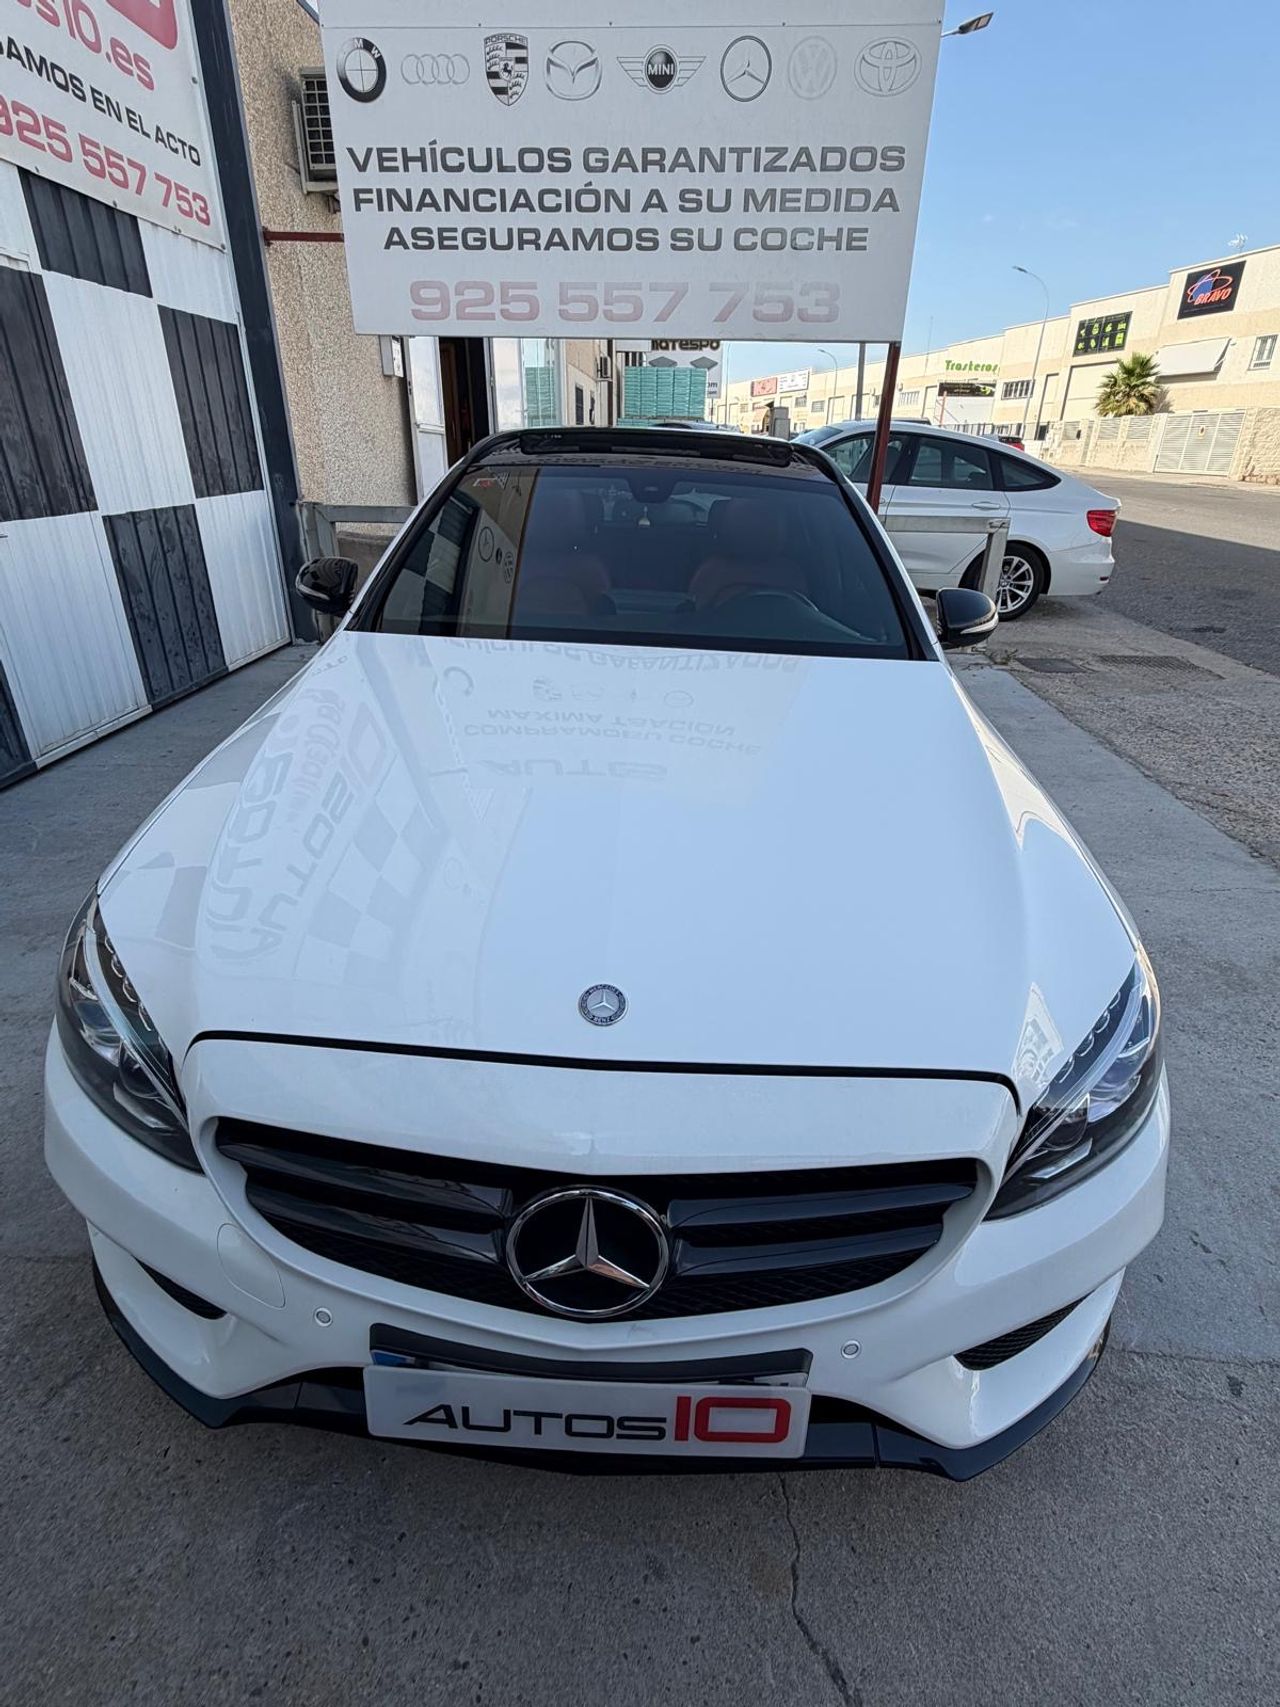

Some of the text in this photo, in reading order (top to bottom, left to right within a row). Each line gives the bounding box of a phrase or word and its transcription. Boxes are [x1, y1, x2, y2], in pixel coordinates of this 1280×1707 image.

[648, 63, 674, 76] MINI
[0, 36, 201, 166] AMOS EN EL ACTO
[346, 139, 906, 173] VEHÍCULOS GARANTIZADOS
[79, 133, 147, 196] 557
[154, 171, 211, 226] 753
[352, 181, 900, 213] FINANCIACIÓN A SU MEDIDA
[384, 227, 869, 251] ASEGURAMOS SU COCHE
[409, 280, 840, 323] 925 557 753
[1194, 287, 1233, 306] BRAVO
[402, 1395, 792, 1444] AUTOS10
